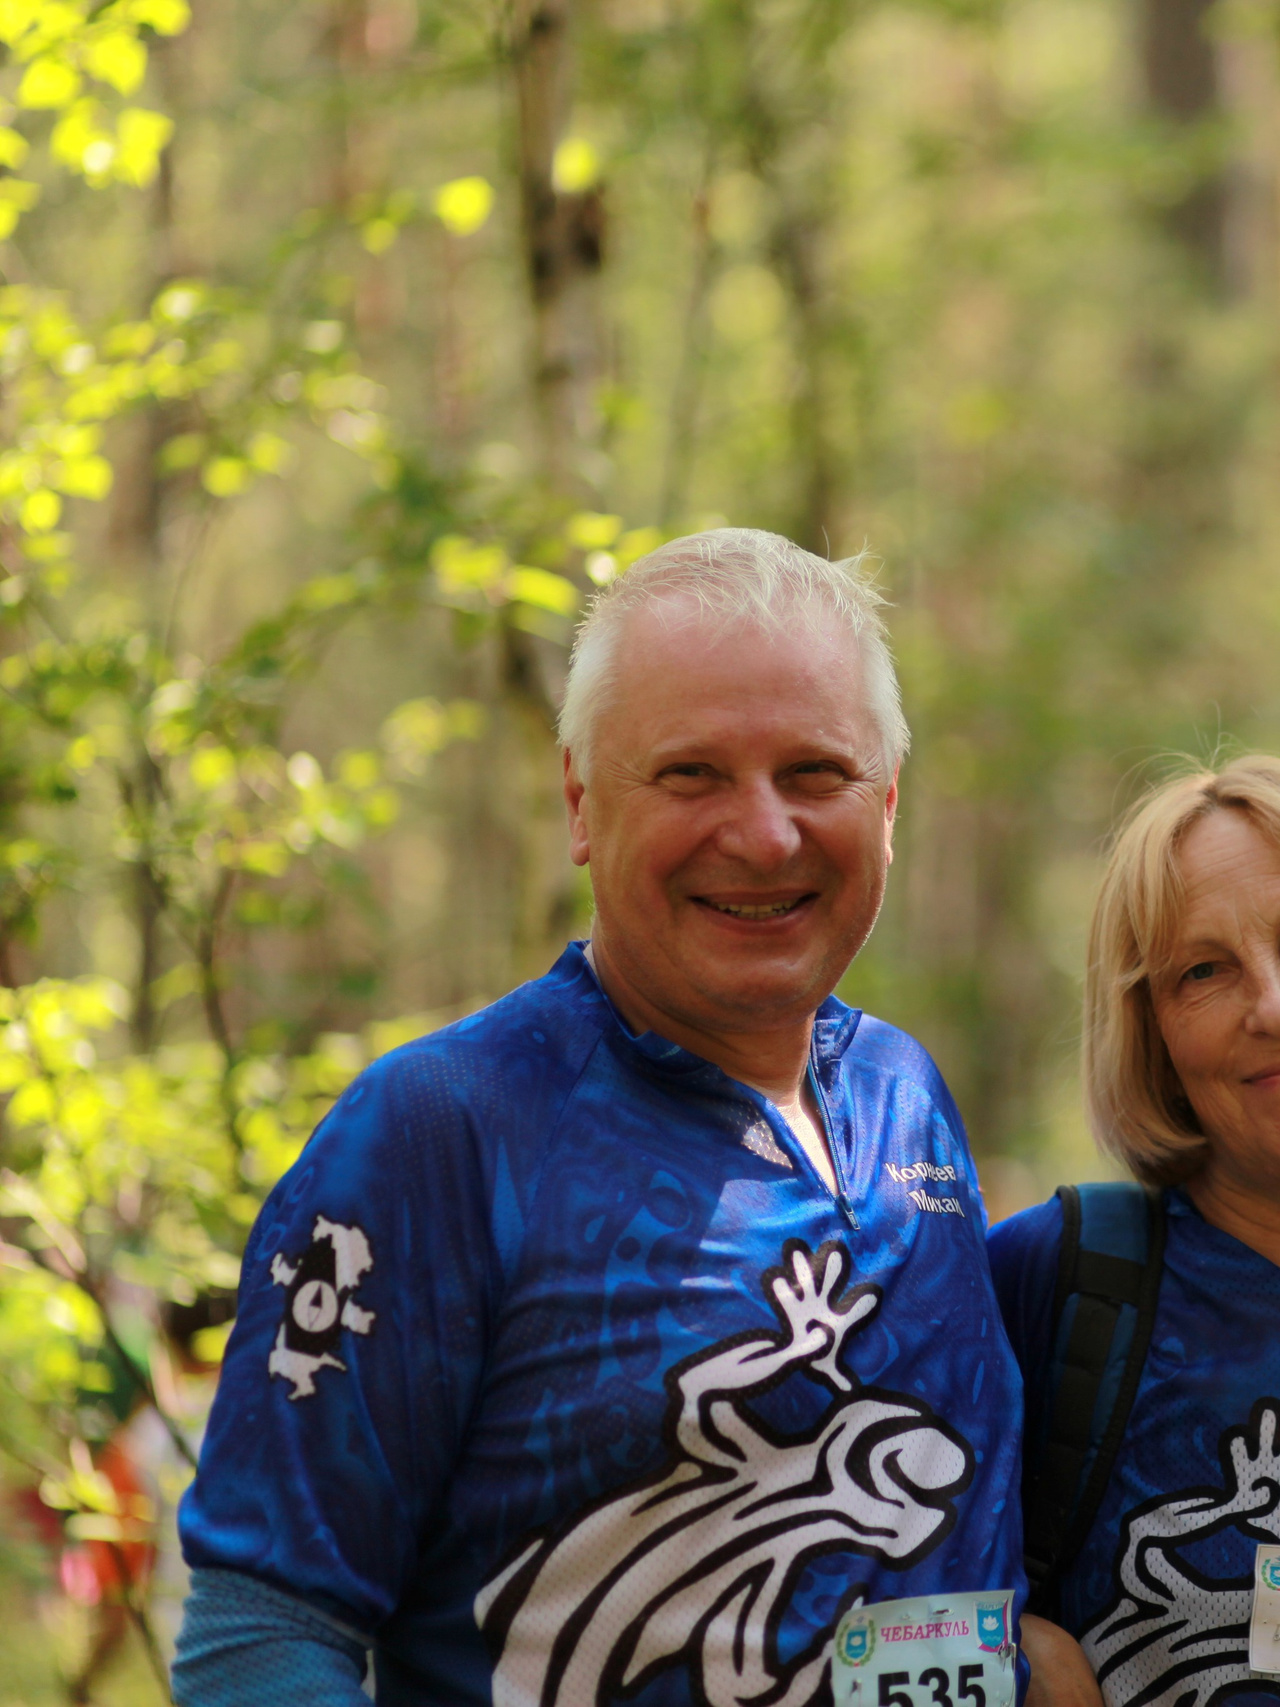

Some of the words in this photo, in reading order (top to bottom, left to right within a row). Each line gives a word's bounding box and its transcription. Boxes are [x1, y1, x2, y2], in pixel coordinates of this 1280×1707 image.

[907, 1189, 966, 1218] Михаи
[880, 1620, 970, 1643] ЧЕБАРКУЛЬ
[877, 1663, 987, 1707] 535
